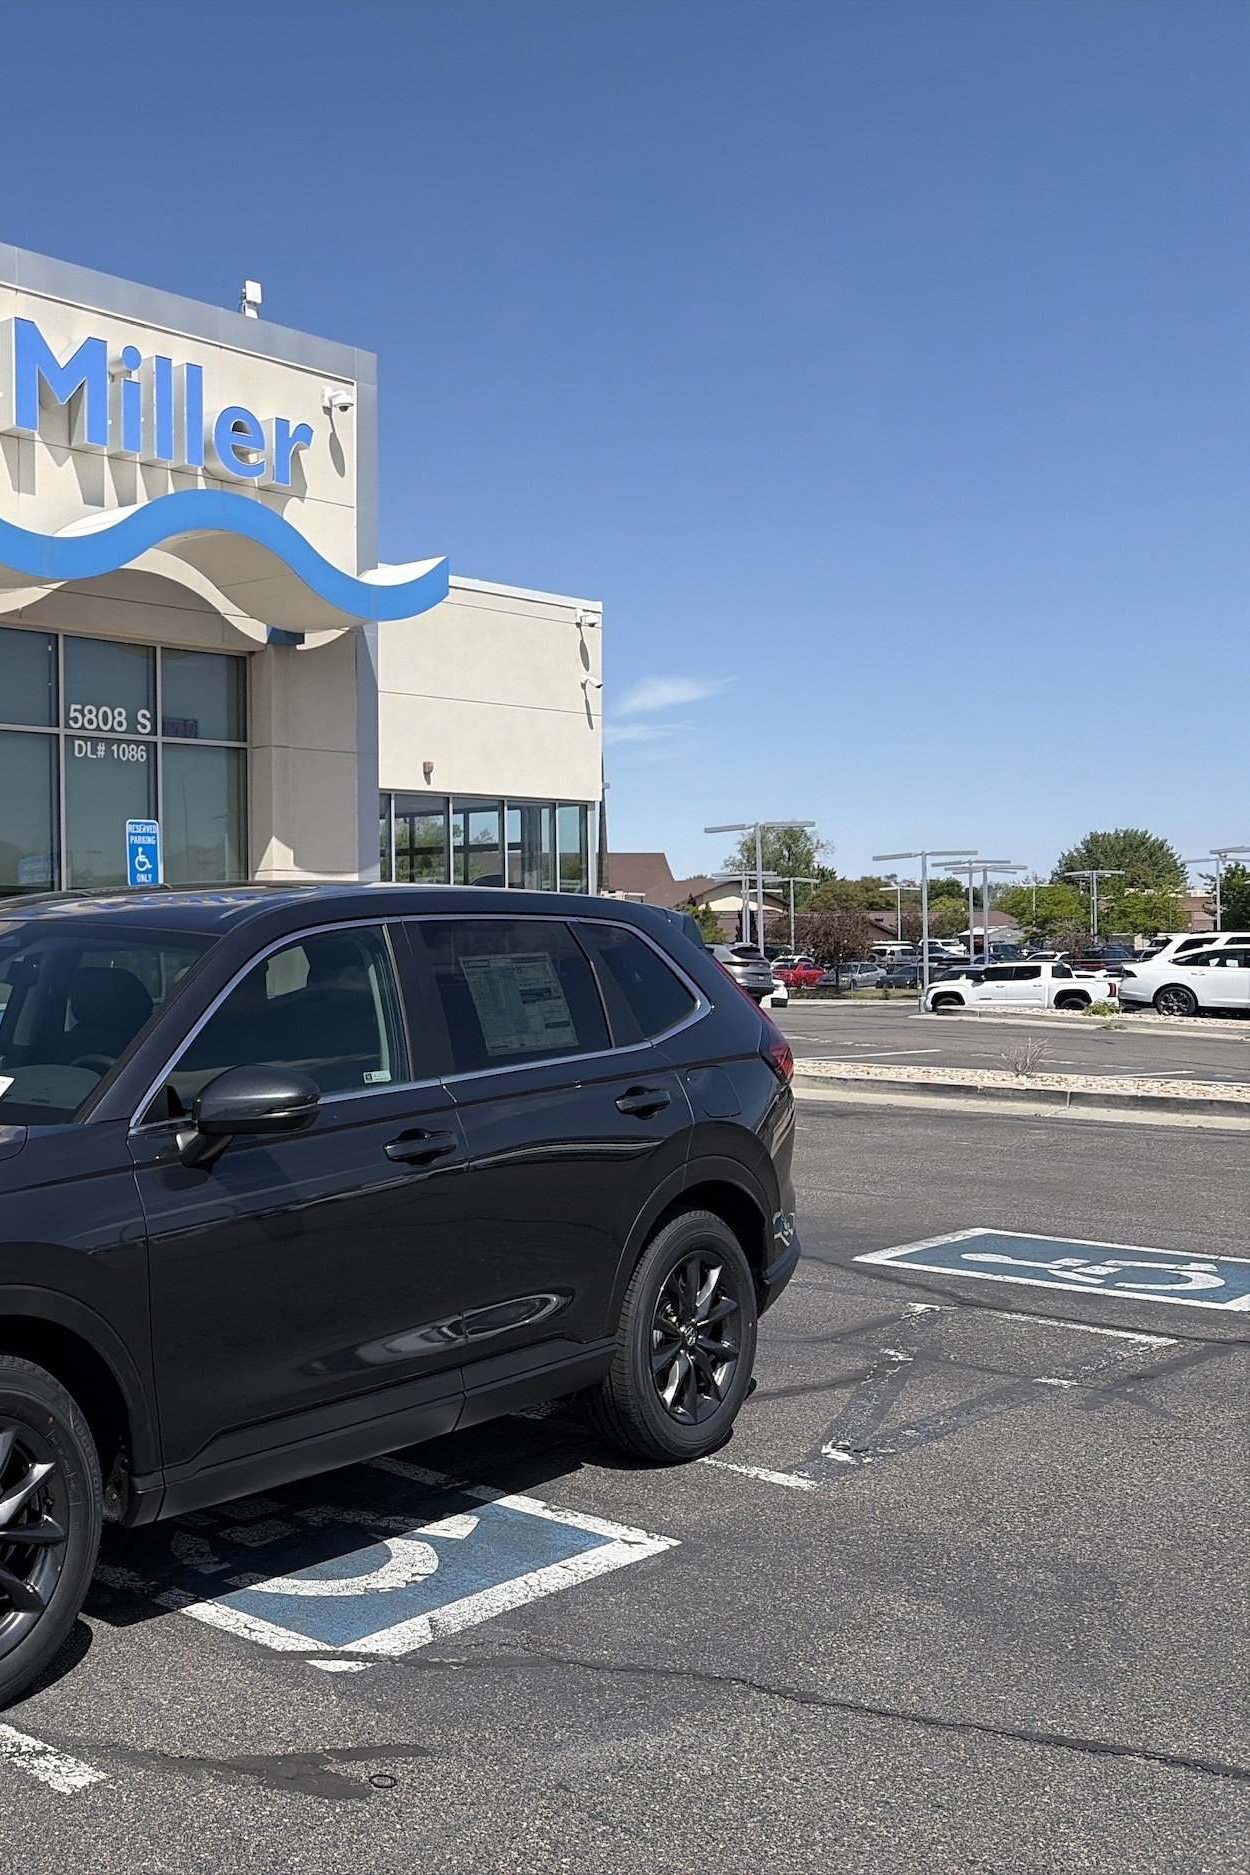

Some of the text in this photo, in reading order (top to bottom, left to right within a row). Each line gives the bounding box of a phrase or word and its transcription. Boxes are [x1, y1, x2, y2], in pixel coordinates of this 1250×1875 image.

[8, 316, 314, 488] Miller
[68, 704, 151, 734] 5808 S
[74, 740, 147, 762] DL# 1086
[128, 824, 157, 834] RESERVED
[130, 835, 156, 845] PARKING
[136, 873, 152, 883] ONLY
